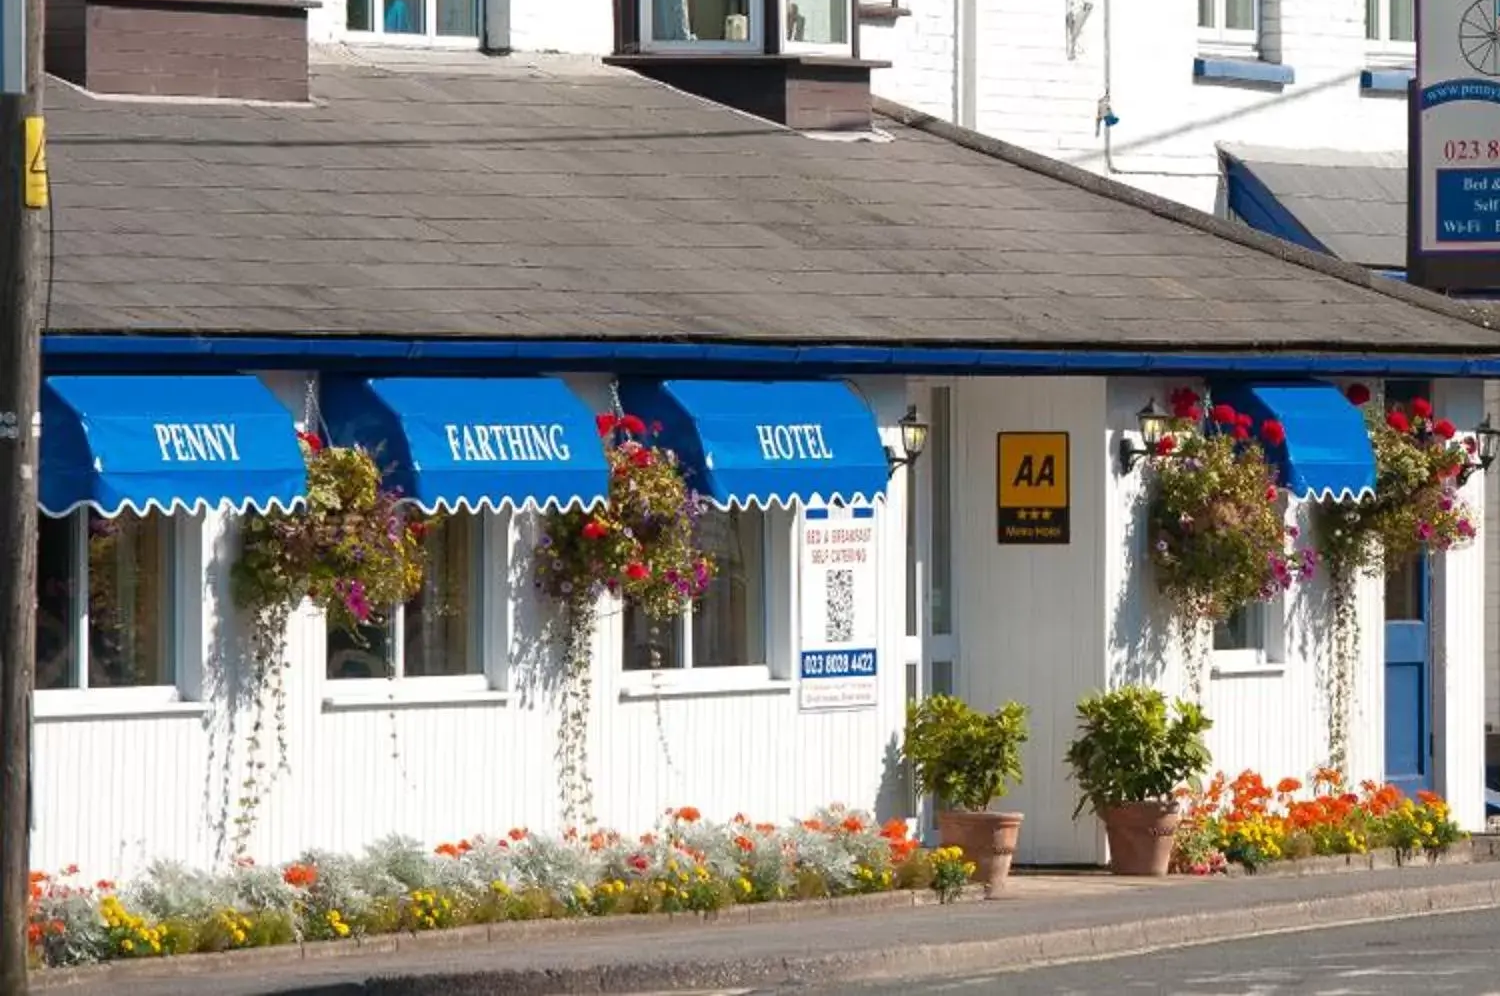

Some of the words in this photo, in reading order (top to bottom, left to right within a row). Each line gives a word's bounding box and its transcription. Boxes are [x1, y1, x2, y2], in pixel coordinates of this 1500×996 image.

[1444, 140, 1480, 160] 023
[1463, 178, 1488, 191] Bed
[1473, 199, 1498, 212] Self
[153, 422, 240, 461] PENNY
[444, 423, 570, 461] FARTHING
[756, 424, 833, 460] HOTEL
[1012, 454, 1055, 487] AA
